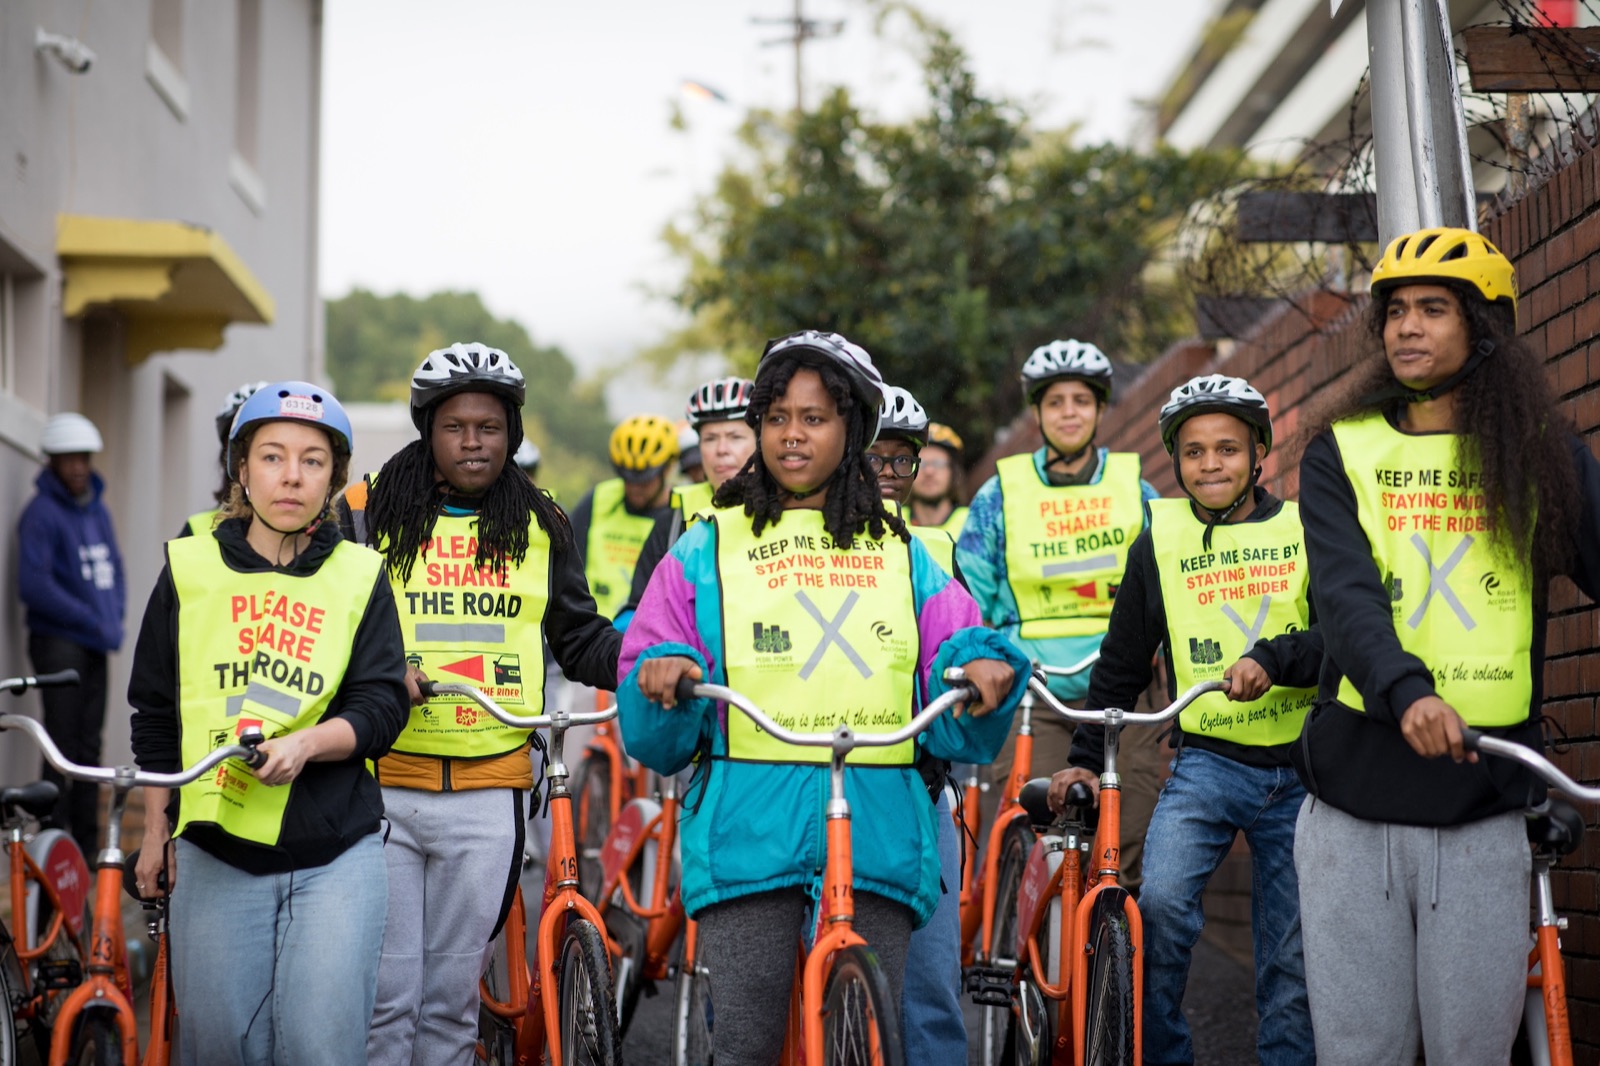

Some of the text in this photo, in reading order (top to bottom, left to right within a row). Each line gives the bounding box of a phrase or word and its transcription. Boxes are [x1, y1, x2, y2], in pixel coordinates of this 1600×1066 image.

[286, 400, 318, 412] 63128
[1375, 468, 1413, 488] KEEP
[1418, 469, 1442, 486] ME
[1040, 496, 1112, 518] PLEASE
[1381, 491, 1447, 510] STAYING
[1046, 512, 1111, 537] SHARE
[1387, 514, 1407, 531] OF
[1412, 514, 1441, 531] THE
[748, 538, 789, 562] KEEP
[794, 535, 817, 551] ME
[864, 540, 885, 551] BY
[1030, 528, 1125, 558] THE ROAD
[755, 554, 885, 576] STAYING WIDER
[1180, 542, 1300, 573] KEEP ME SAFE BY
[768, 572, 878, 589] OF THE RIDER
[1186, 561, 1296, 590] STAYING WIDER
[405, 591, 522, 618] THE ROAD
[1197, 579, 1289, 606] OF THE RIDER
[238, 622, 316, 663] SARE
[252, 650, 325, 696] ROAD
[1437, 661, 1514, 687] of the solution
[496, 688, 520, 697] RIDER
[800, 712, 808, 727] is
[812, 713, 836, 732] part
[854, 707, 868, 726] the
[1200, 712, 1233, 732] Cycling
[1236, 711, 1244, 724] is
[1247, 707, 1267, 726] part
[1269, 702, 1278, 722] of
[1281, 697, 1293, 715] the
[561, 856, 577, 877] 16
[1103, 848, 1119, 861] 47
